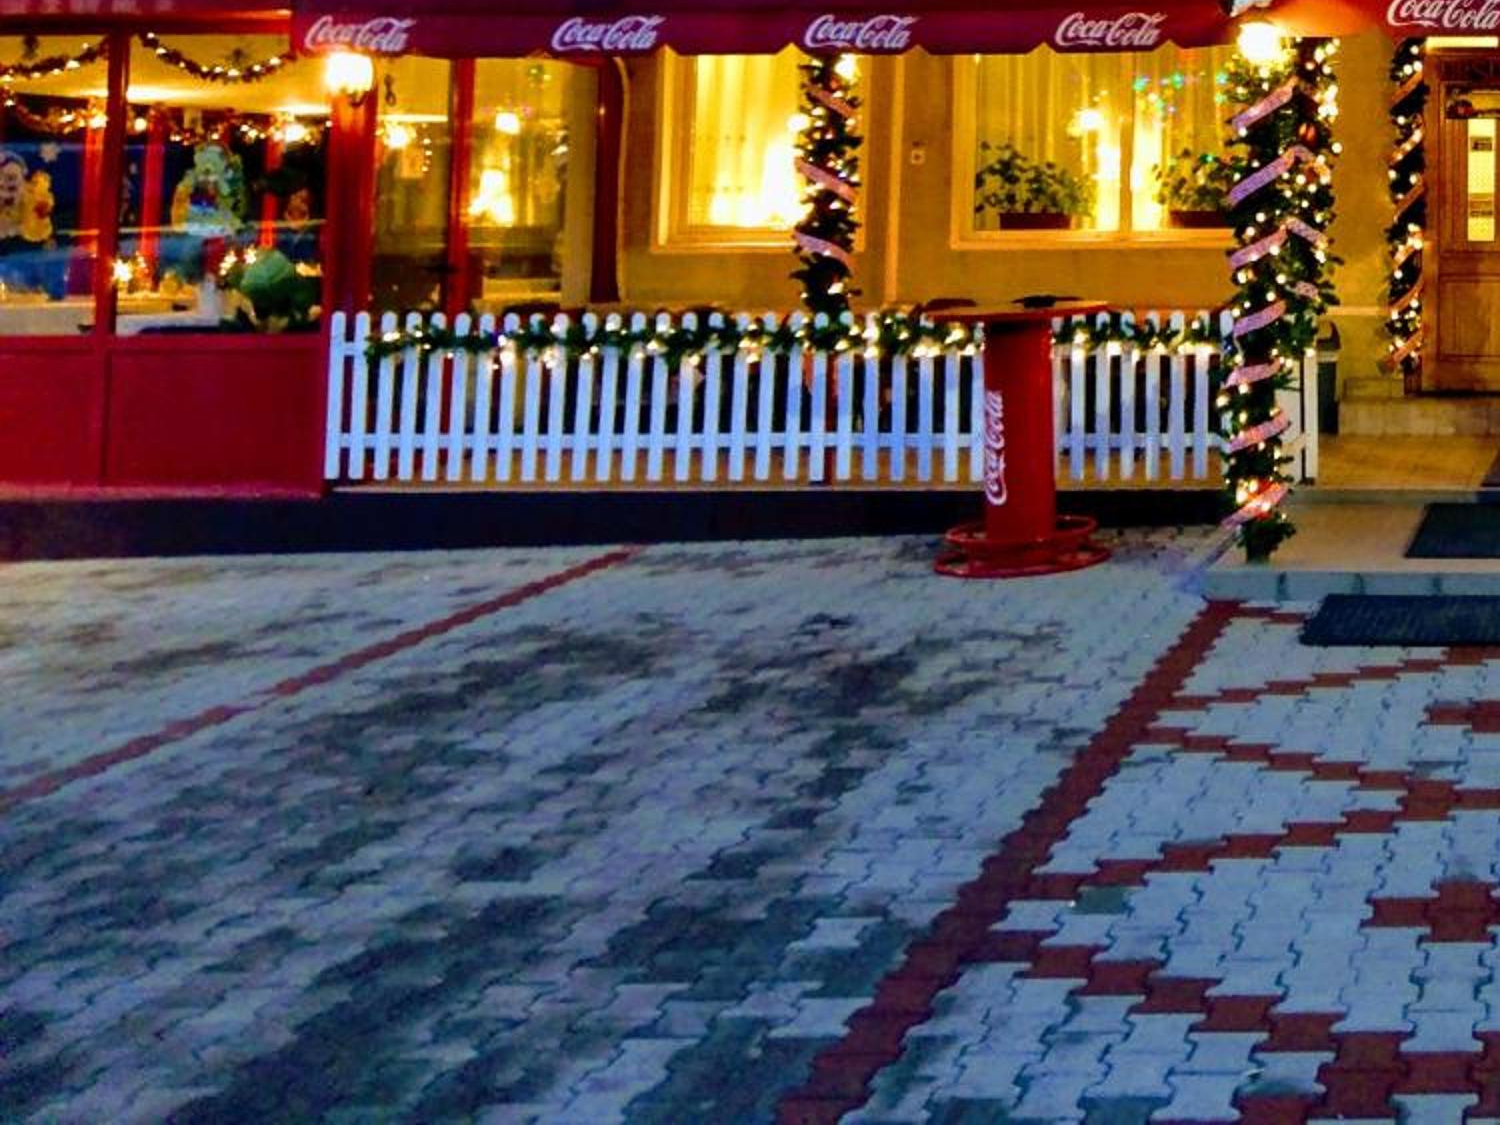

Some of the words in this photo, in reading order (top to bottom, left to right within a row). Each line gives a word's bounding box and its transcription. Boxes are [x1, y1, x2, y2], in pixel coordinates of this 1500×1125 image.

[304, 15, 417, 52] Coca-Cola
[551, 15, 666, 51] Coca-Cola
[804, 13, 921, 49] Coca-Cola
[1055, 12, 1169, 47] Coca-Cola
